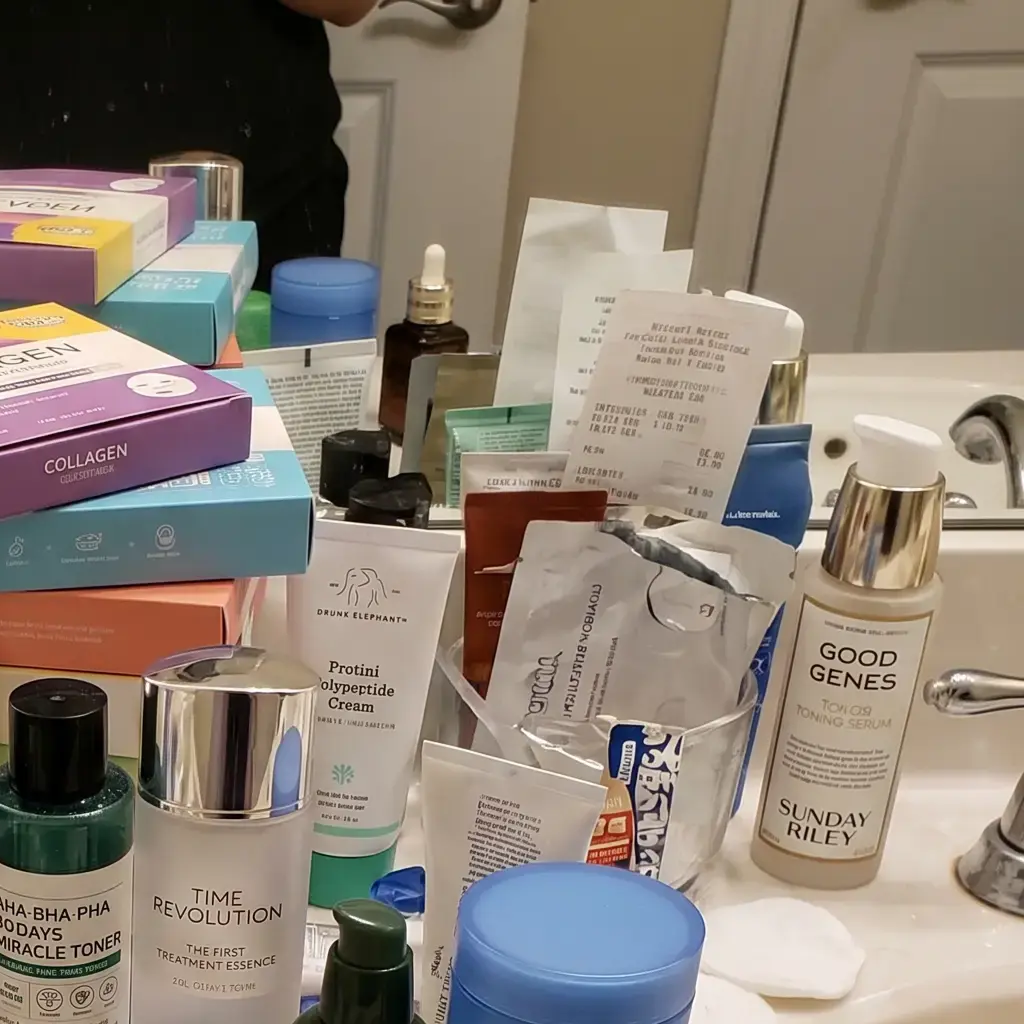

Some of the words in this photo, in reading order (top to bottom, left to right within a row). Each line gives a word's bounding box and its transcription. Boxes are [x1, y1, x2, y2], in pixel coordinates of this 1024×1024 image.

[44, 443, 129, 475] COLLAGEN
[317, 608, 349, 619] DRUNK
[820, 642, 898, 667] GOOD
[328, 661, 380, 678] Protini
[809, 664, 897, 691] GENES
[319, 677, 395, 697] olypeptide
[328, 697, 375, 714] Cream
[778, 798, 872, 828] SUNDAY
[787, 821, 857, 846] RILEY
[192, 888, 243, 906] TIME
[153, 895, 283, 925] REVOLUTION
[71, 931, 121, 958] TONER
[186, 944, 210, 956] THE
[213, 946, 246, 957] FIRST
[156, 947, 224, 971] TREATMENT
[226, 954, 276, 971] ESSENCE
